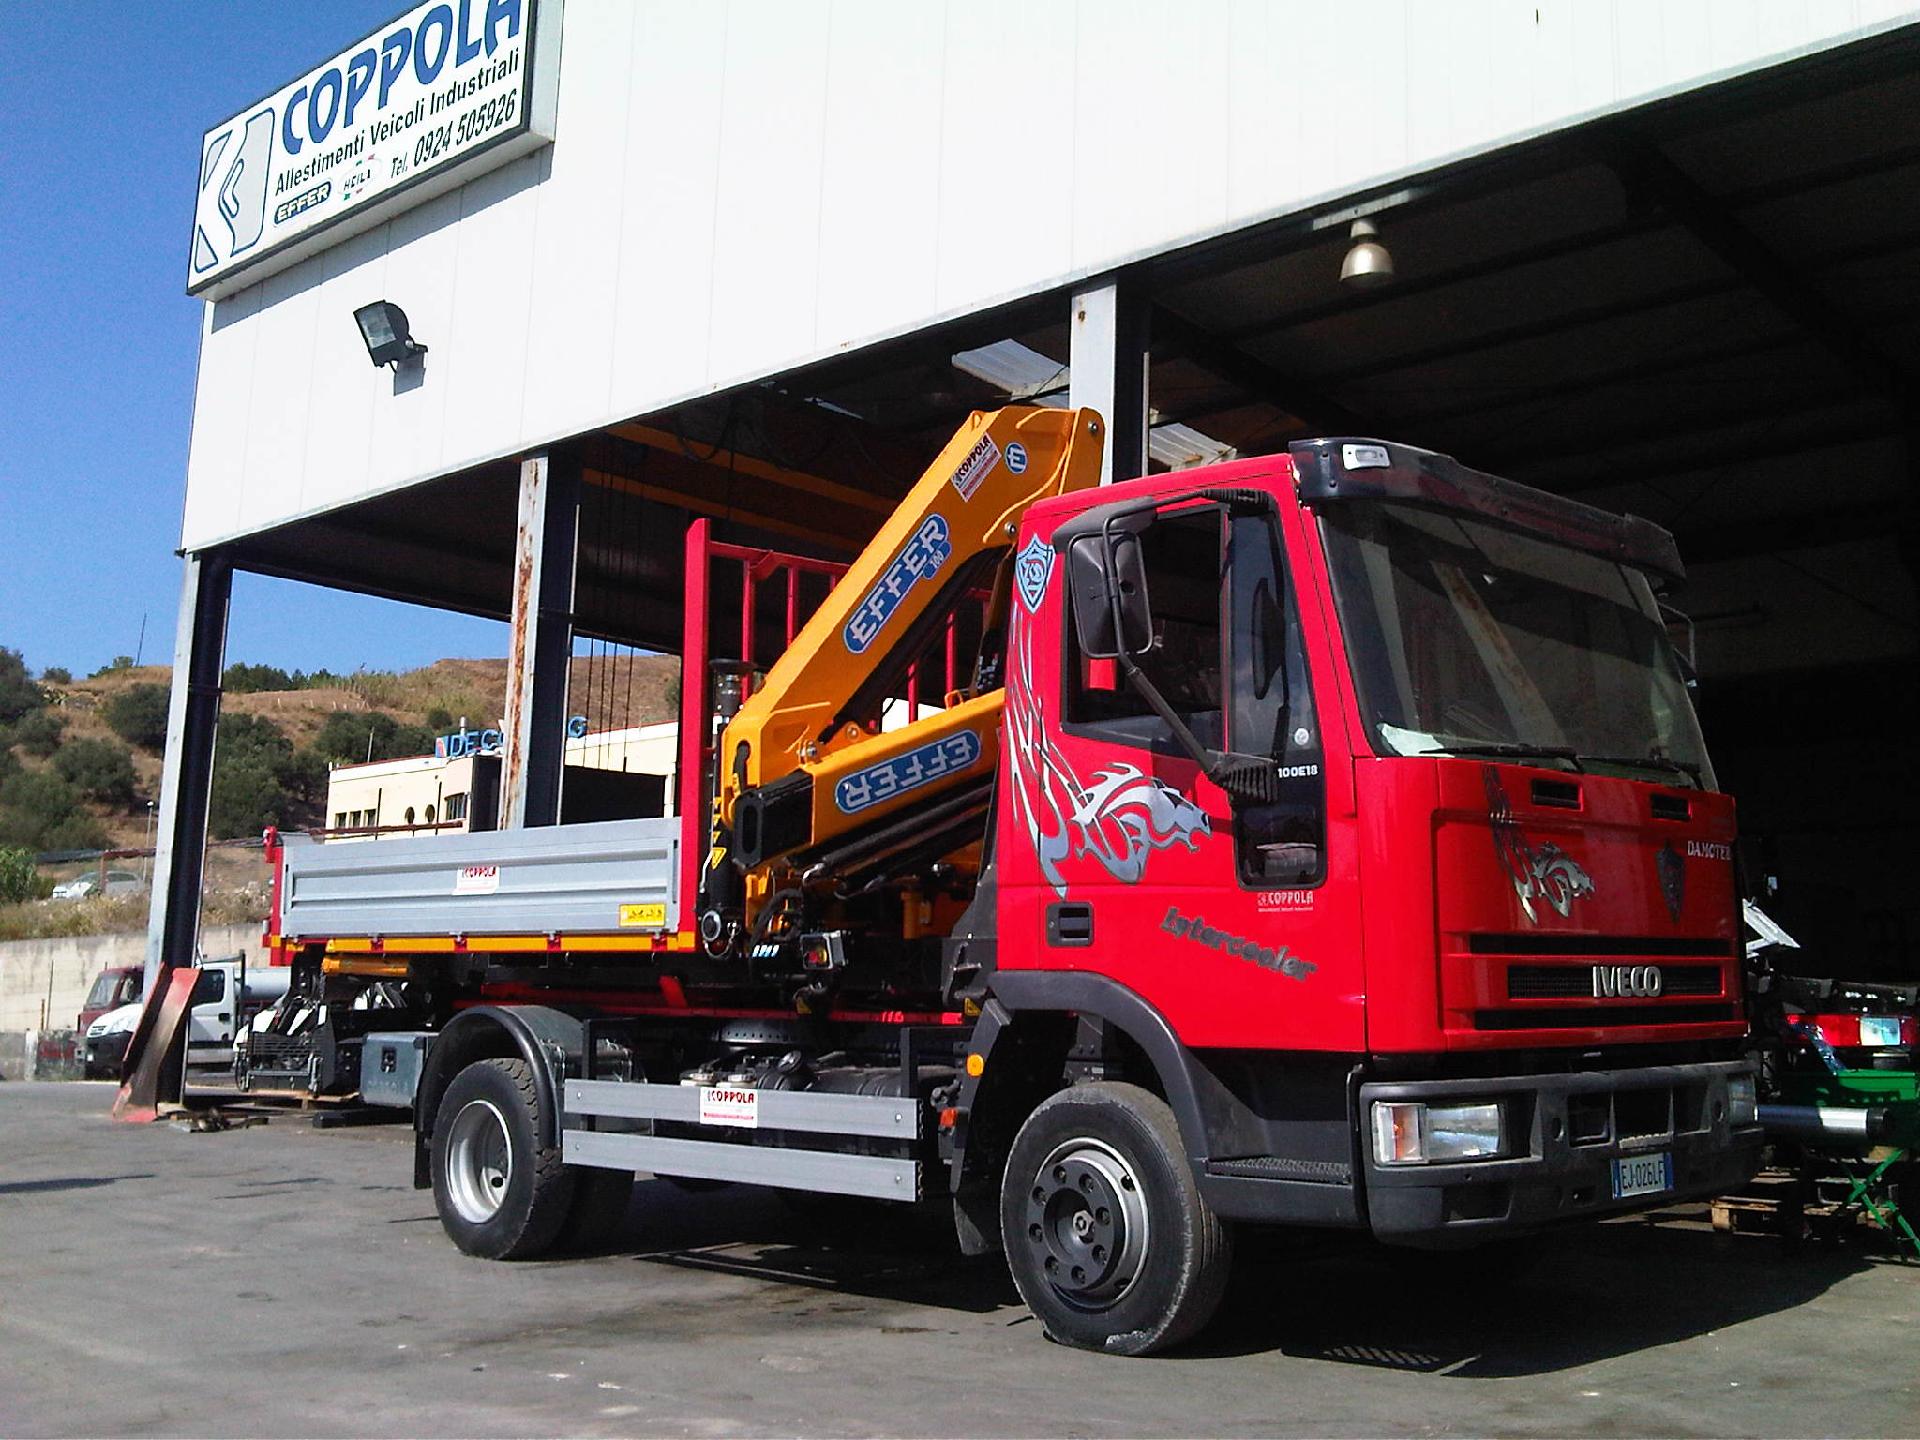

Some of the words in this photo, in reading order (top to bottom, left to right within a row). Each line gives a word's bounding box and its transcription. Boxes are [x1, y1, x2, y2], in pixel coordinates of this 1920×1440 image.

[282, 0, 521, 154] COPPOLA
[275, 133, 364, 196] Allestimenti
[370, 98, 425, 144] Veicoli
[430, 47, 519, 115] Industriali
[414, 120, 453, 167] 0924
[456, 88, 517, 146] 505926
[276, 182, 331, 223] EFFER
[958, 434, 991, 477] COPPOLA
[849, 519, 945, 644] EFFER
[843, 736, 973, 807] EFFER
[1278, 764, 1319, 779] 100E18
[1267, 891, 1314, 905] COPPOLA
[1592, 965, 1663, 998] IVECO
[711, 1090, 754, 1104] COPPOLA
